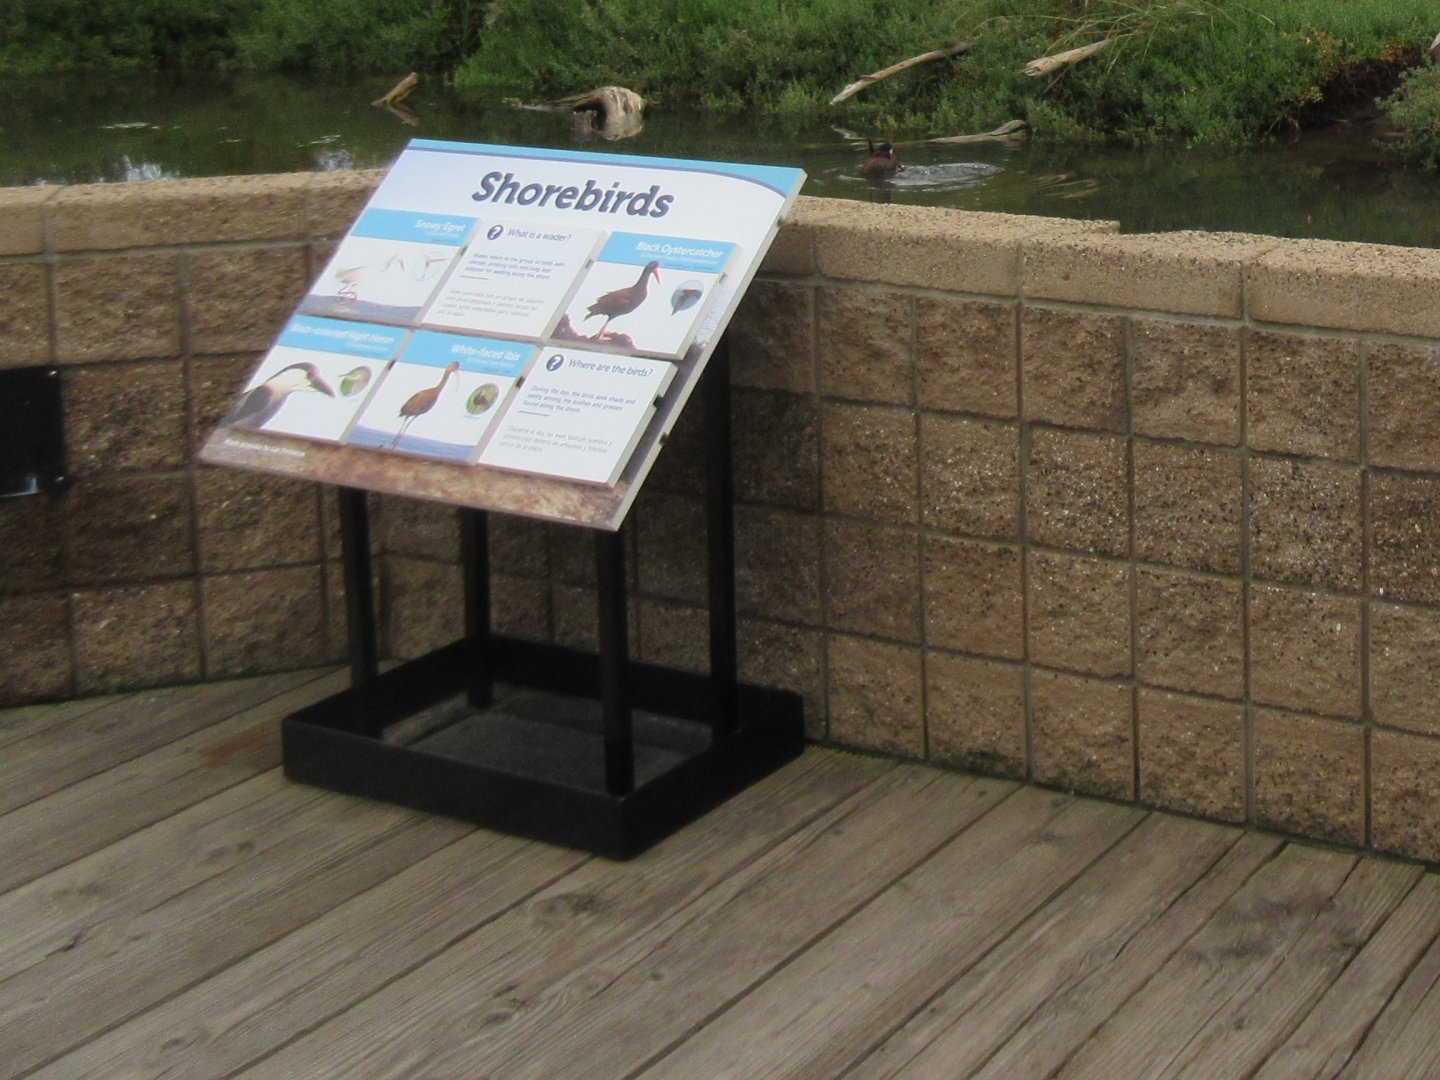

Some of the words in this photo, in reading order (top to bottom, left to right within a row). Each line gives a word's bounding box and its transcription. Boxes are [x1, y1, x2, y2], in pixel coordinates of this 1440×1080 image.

[472, 171, 674, 218] Shorebirds
[508, 228, 529, 238] What
[528, 231, 535, 239] is
[543, 231, 572, 242] wader?
[637, 241, 660, 251] Black
[661, 244, 723, 258] Oystercatcher
[568, 358, 596, 370] Where
[596, 363, 611, 372] are
[611, 364, 626, 374] the
[626, 365, 655, 377] birds?
